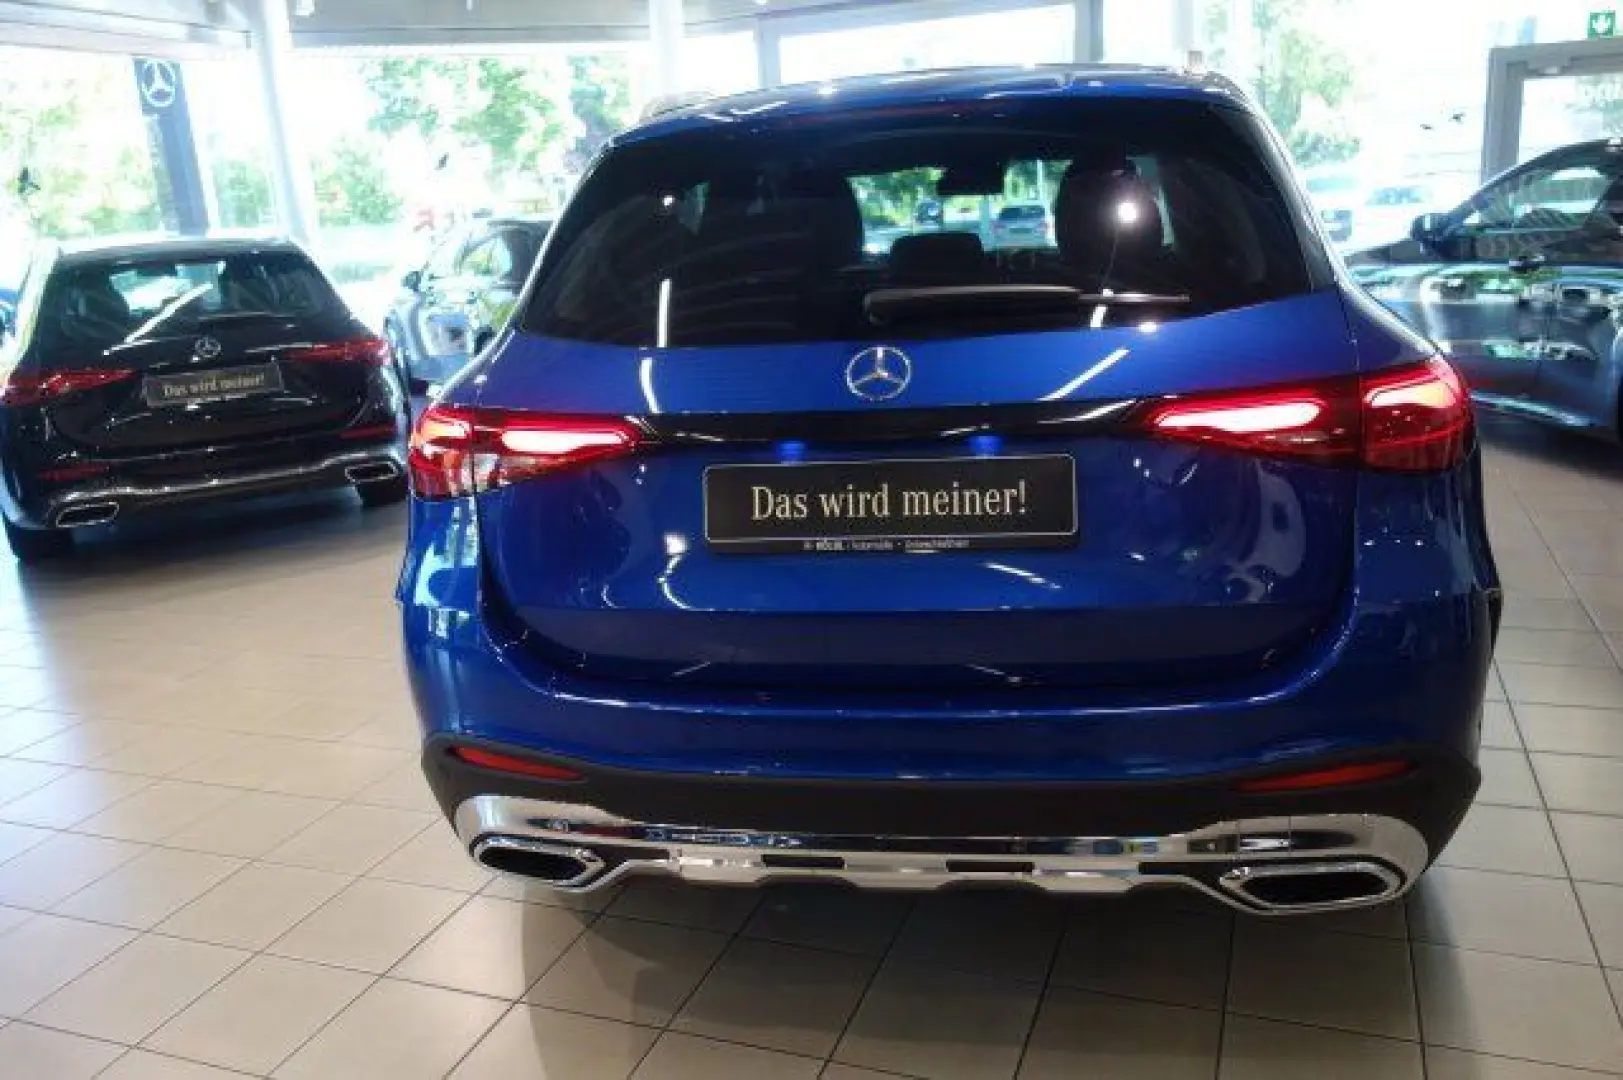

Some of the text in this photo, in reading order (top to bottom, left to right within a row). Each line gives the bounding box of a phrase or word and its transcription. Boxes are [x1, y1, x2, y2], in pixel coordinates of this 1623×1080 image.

[751, 479, 1027, 520] Das wird meiner!
